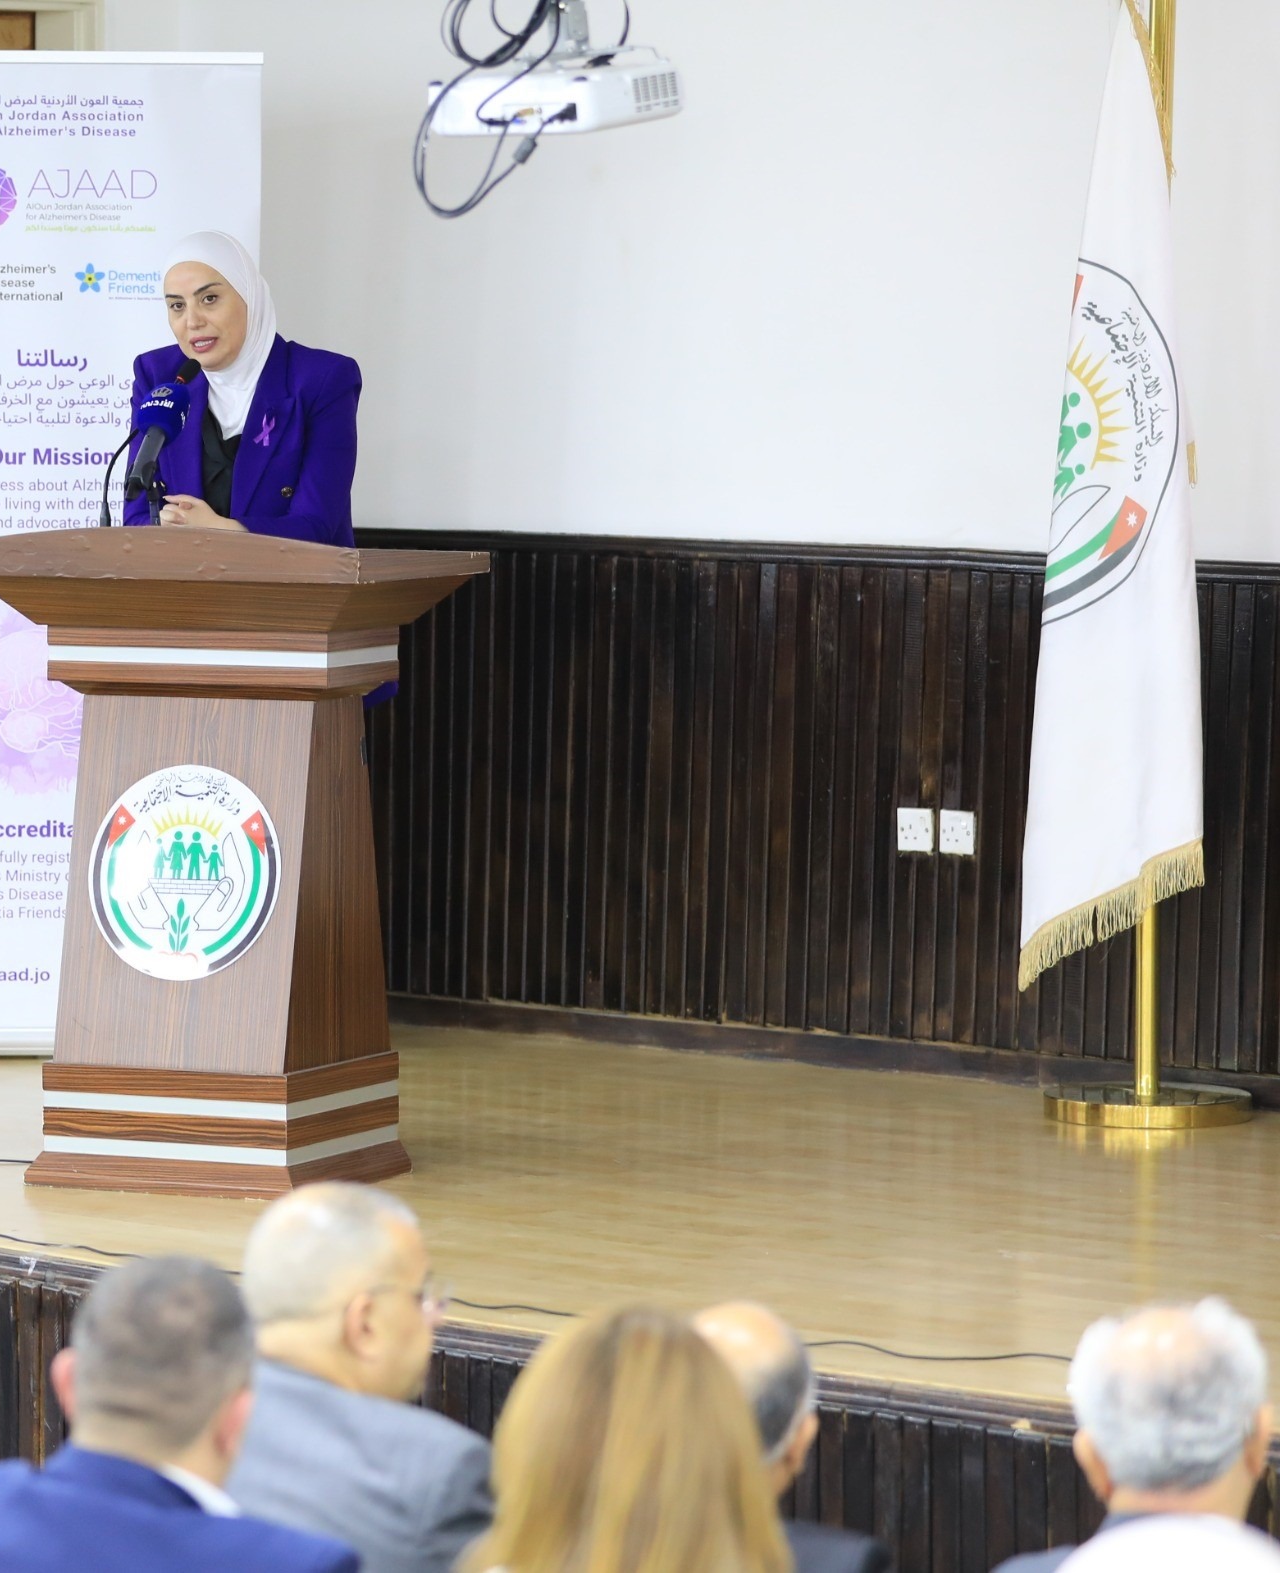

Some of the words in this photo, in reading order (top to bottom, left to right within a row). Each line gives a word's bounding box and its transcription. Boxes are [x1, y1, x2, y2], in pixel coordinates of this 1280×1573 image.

[4, 95, 37, 108] لمرض
[40, 94, 77, 109] الأردنية
[80, 95, 109, 108] العون
[112, 95, 144, 109] جمعية
[8, 110, 56, 121] Jordan
[61, 110, 144, 122] Association
[81, 126, 137, 137] Disease
[27, 168, 158, 199] AJAAD
[54, 202, 83, 211] Jordan
[85, 202, 133, 211] Association
[25, 213, 37, 221] for
[39, 213, 88, 221] Alzheimer's
[90, 213, 122, 221] Disease
[108, 270, 161, 282] Dementi
[108, 283, 155, 294] Friends
[17, 349, 88, 372] رسالتنا
[6, 377, 42, 390] مرض
[46, 374, 74, 390] حول
[79, 374, 115, 393] الوعي
[35, 397, 53, 411] مع
[57, 392, 109, 408] يعيشون
[36, 410, 71, 427] لتلبية
[75, 411, 121, 427] والدعوة
[33, 447, 116, 465] Mission
[28, 478, 68, 491] about
[5, 496, 41, 513] living
[45, 497, 74, 510] with
[17, 516, 80, 528] advocate
[0, 850, 28, 866] fully
[31, 851, 71, 866] regist
[6, 869, 61, 885] Ministry
[9, 888, 63, 900] Disease
[18, 906, 67, 919] Friends
